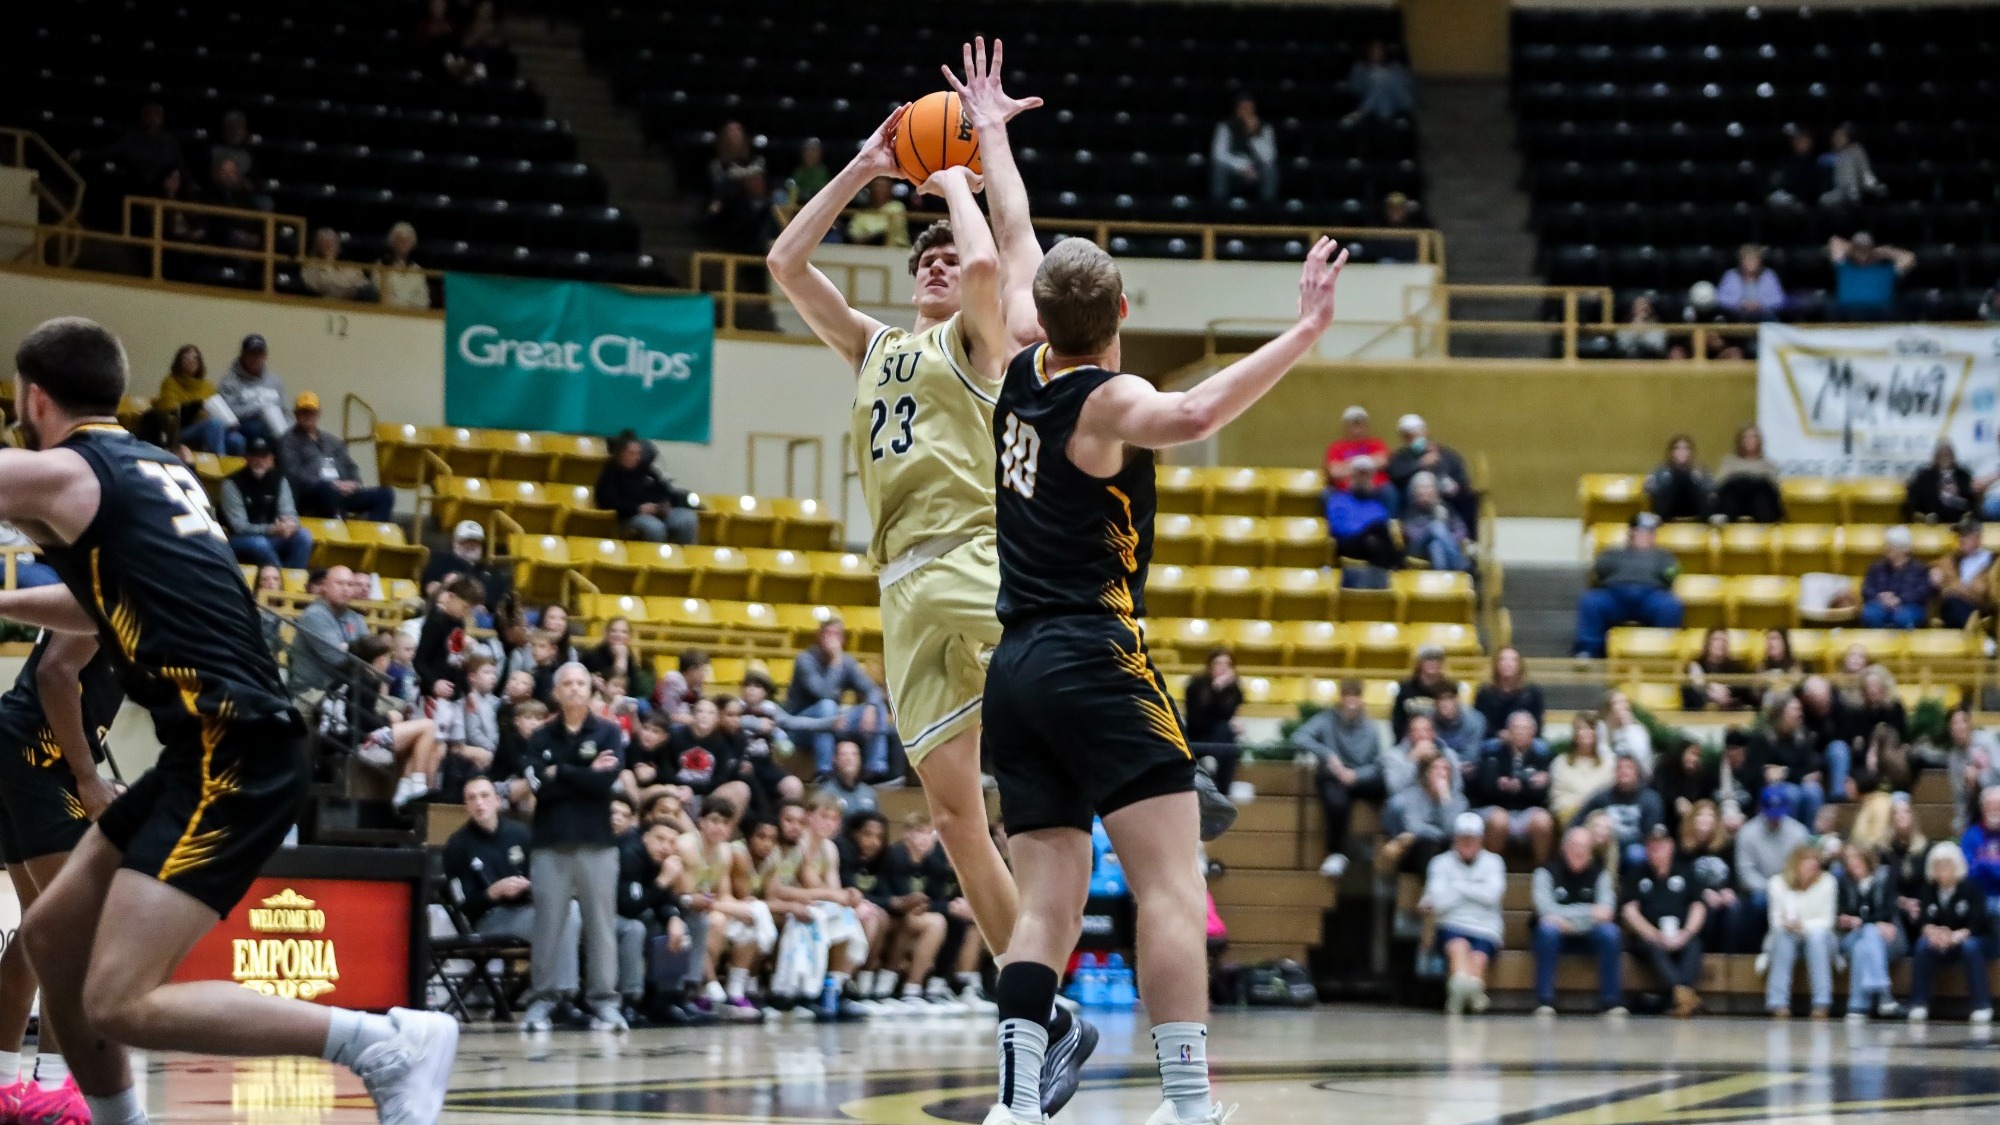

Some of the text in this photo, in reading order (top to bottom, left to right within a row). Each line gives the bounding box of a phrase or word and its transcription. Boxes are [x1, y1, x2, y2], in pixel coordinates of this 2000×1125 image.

[327, 314, 349, 337] 12
[458, 324, 693, 389] Great Clips
[870, 393, 918, 463] 23
[1001, 412, 1041, 499] 10
[249, 908, 326, 933] WELCOME TO
[232, 938, 340, 981] EMPORIA
